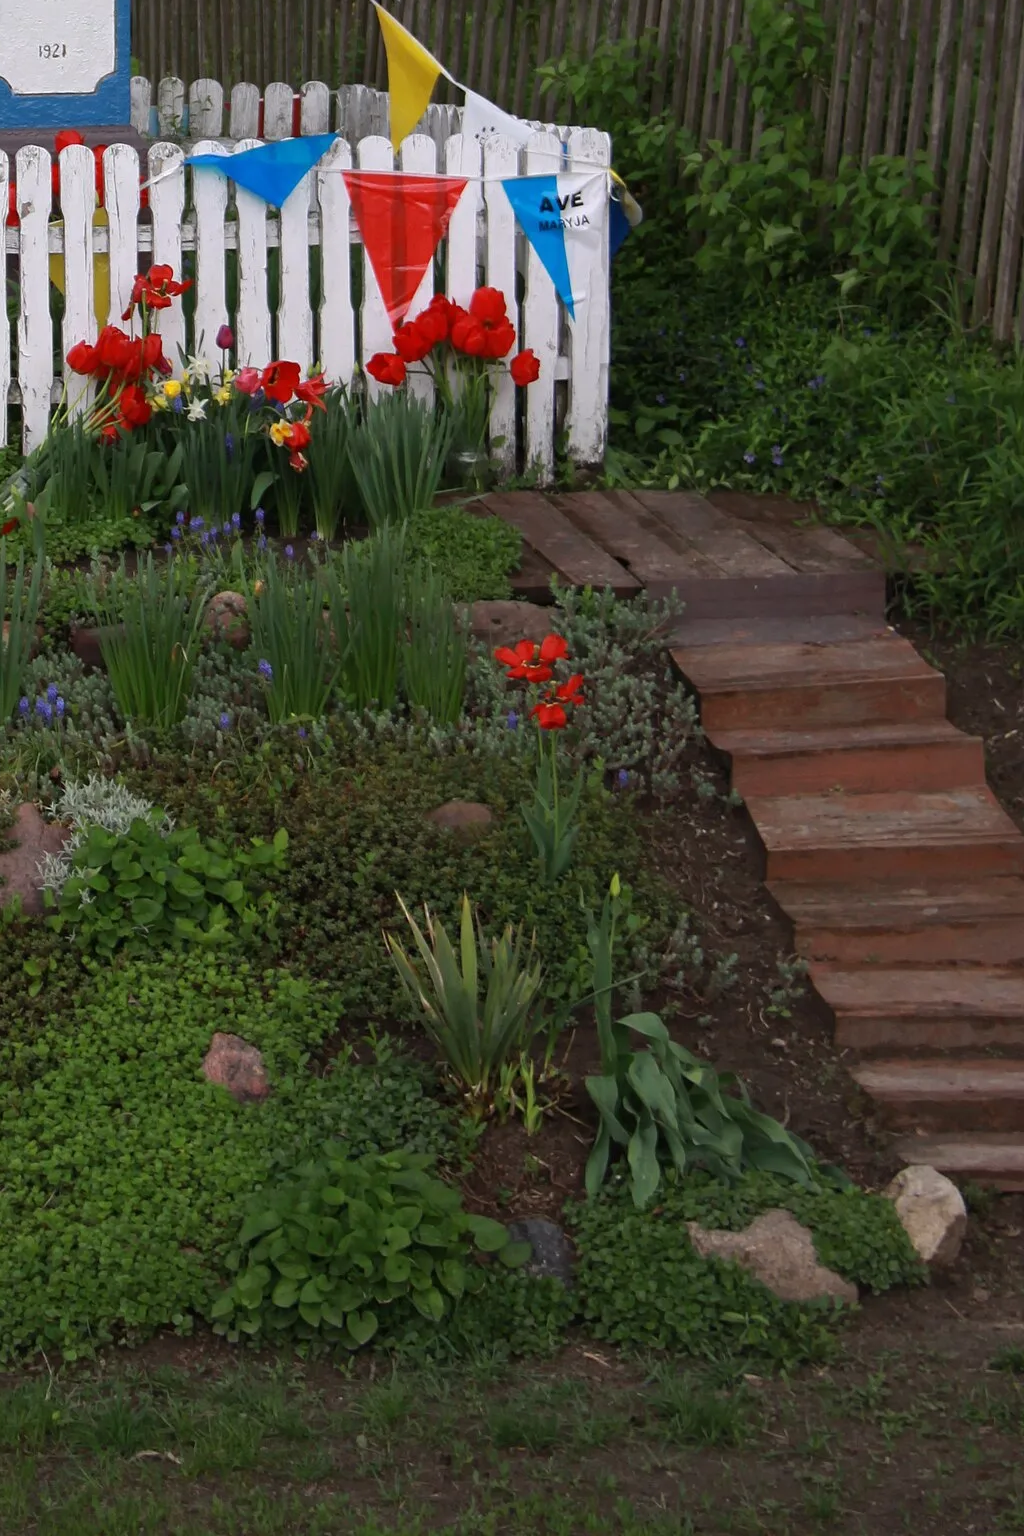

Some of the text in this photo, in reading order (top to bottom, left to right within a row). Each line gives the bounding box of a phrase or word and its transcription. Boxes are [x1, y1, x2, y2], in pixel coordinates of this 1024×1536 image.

[39, 44, 66, 59] 1921
[539, 191, 584, 213] AVE
[538, 214, 591, 232] MARYJA
